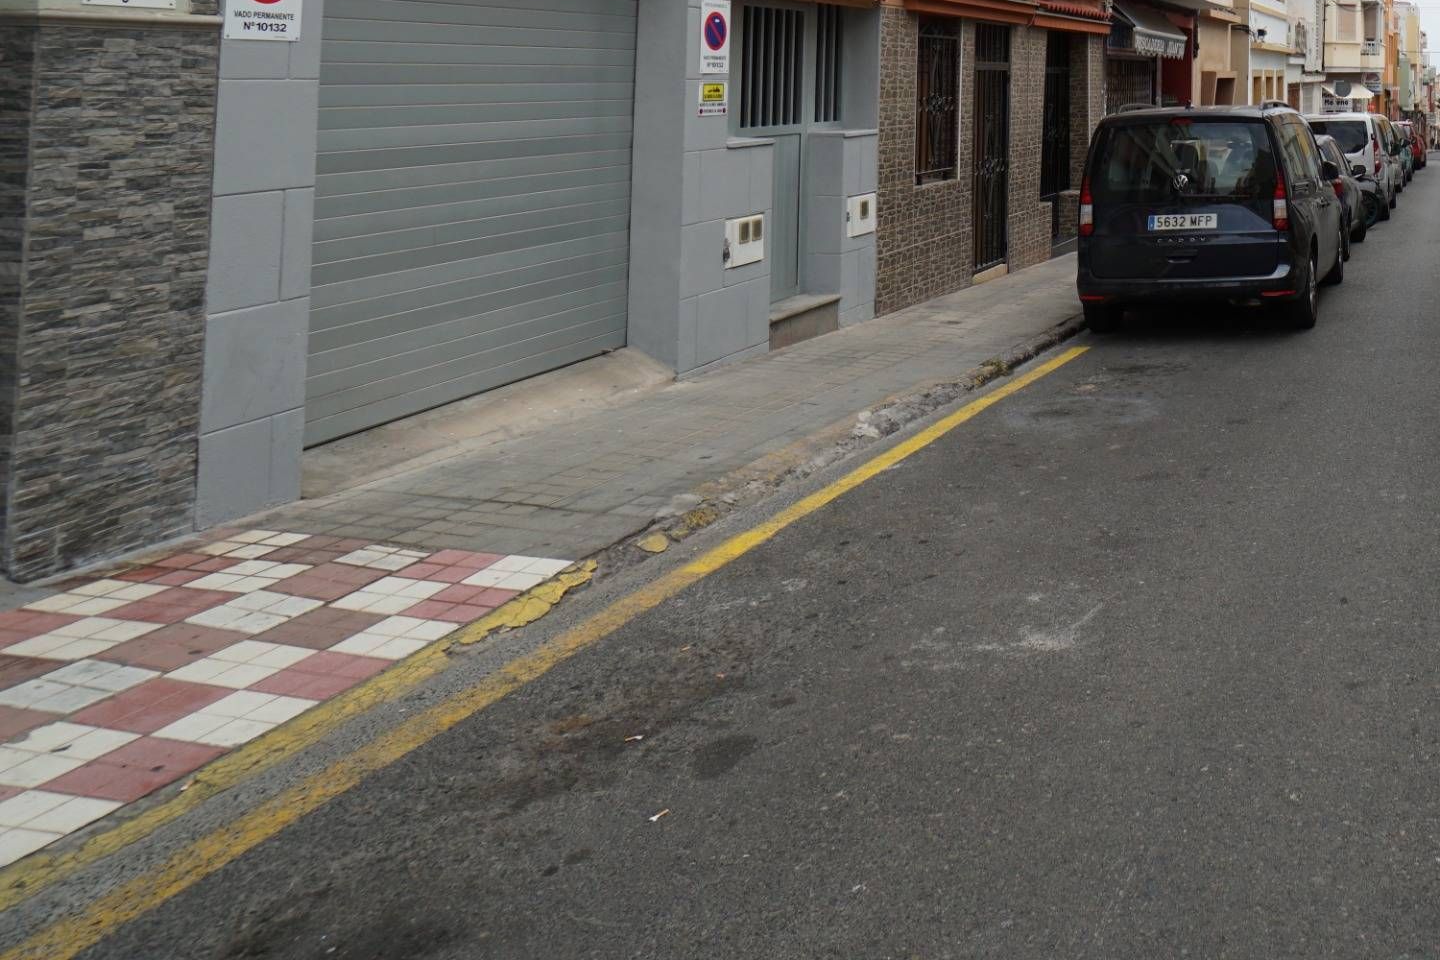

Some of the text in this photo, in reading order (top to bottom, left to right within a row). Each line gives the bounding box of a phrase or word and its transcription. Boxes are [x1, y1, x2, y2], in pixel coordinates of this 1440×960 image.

[234, 10, 295, 22] VADO PERMANENTE
[1156, 215, 1213, 228] 5632 MFP
